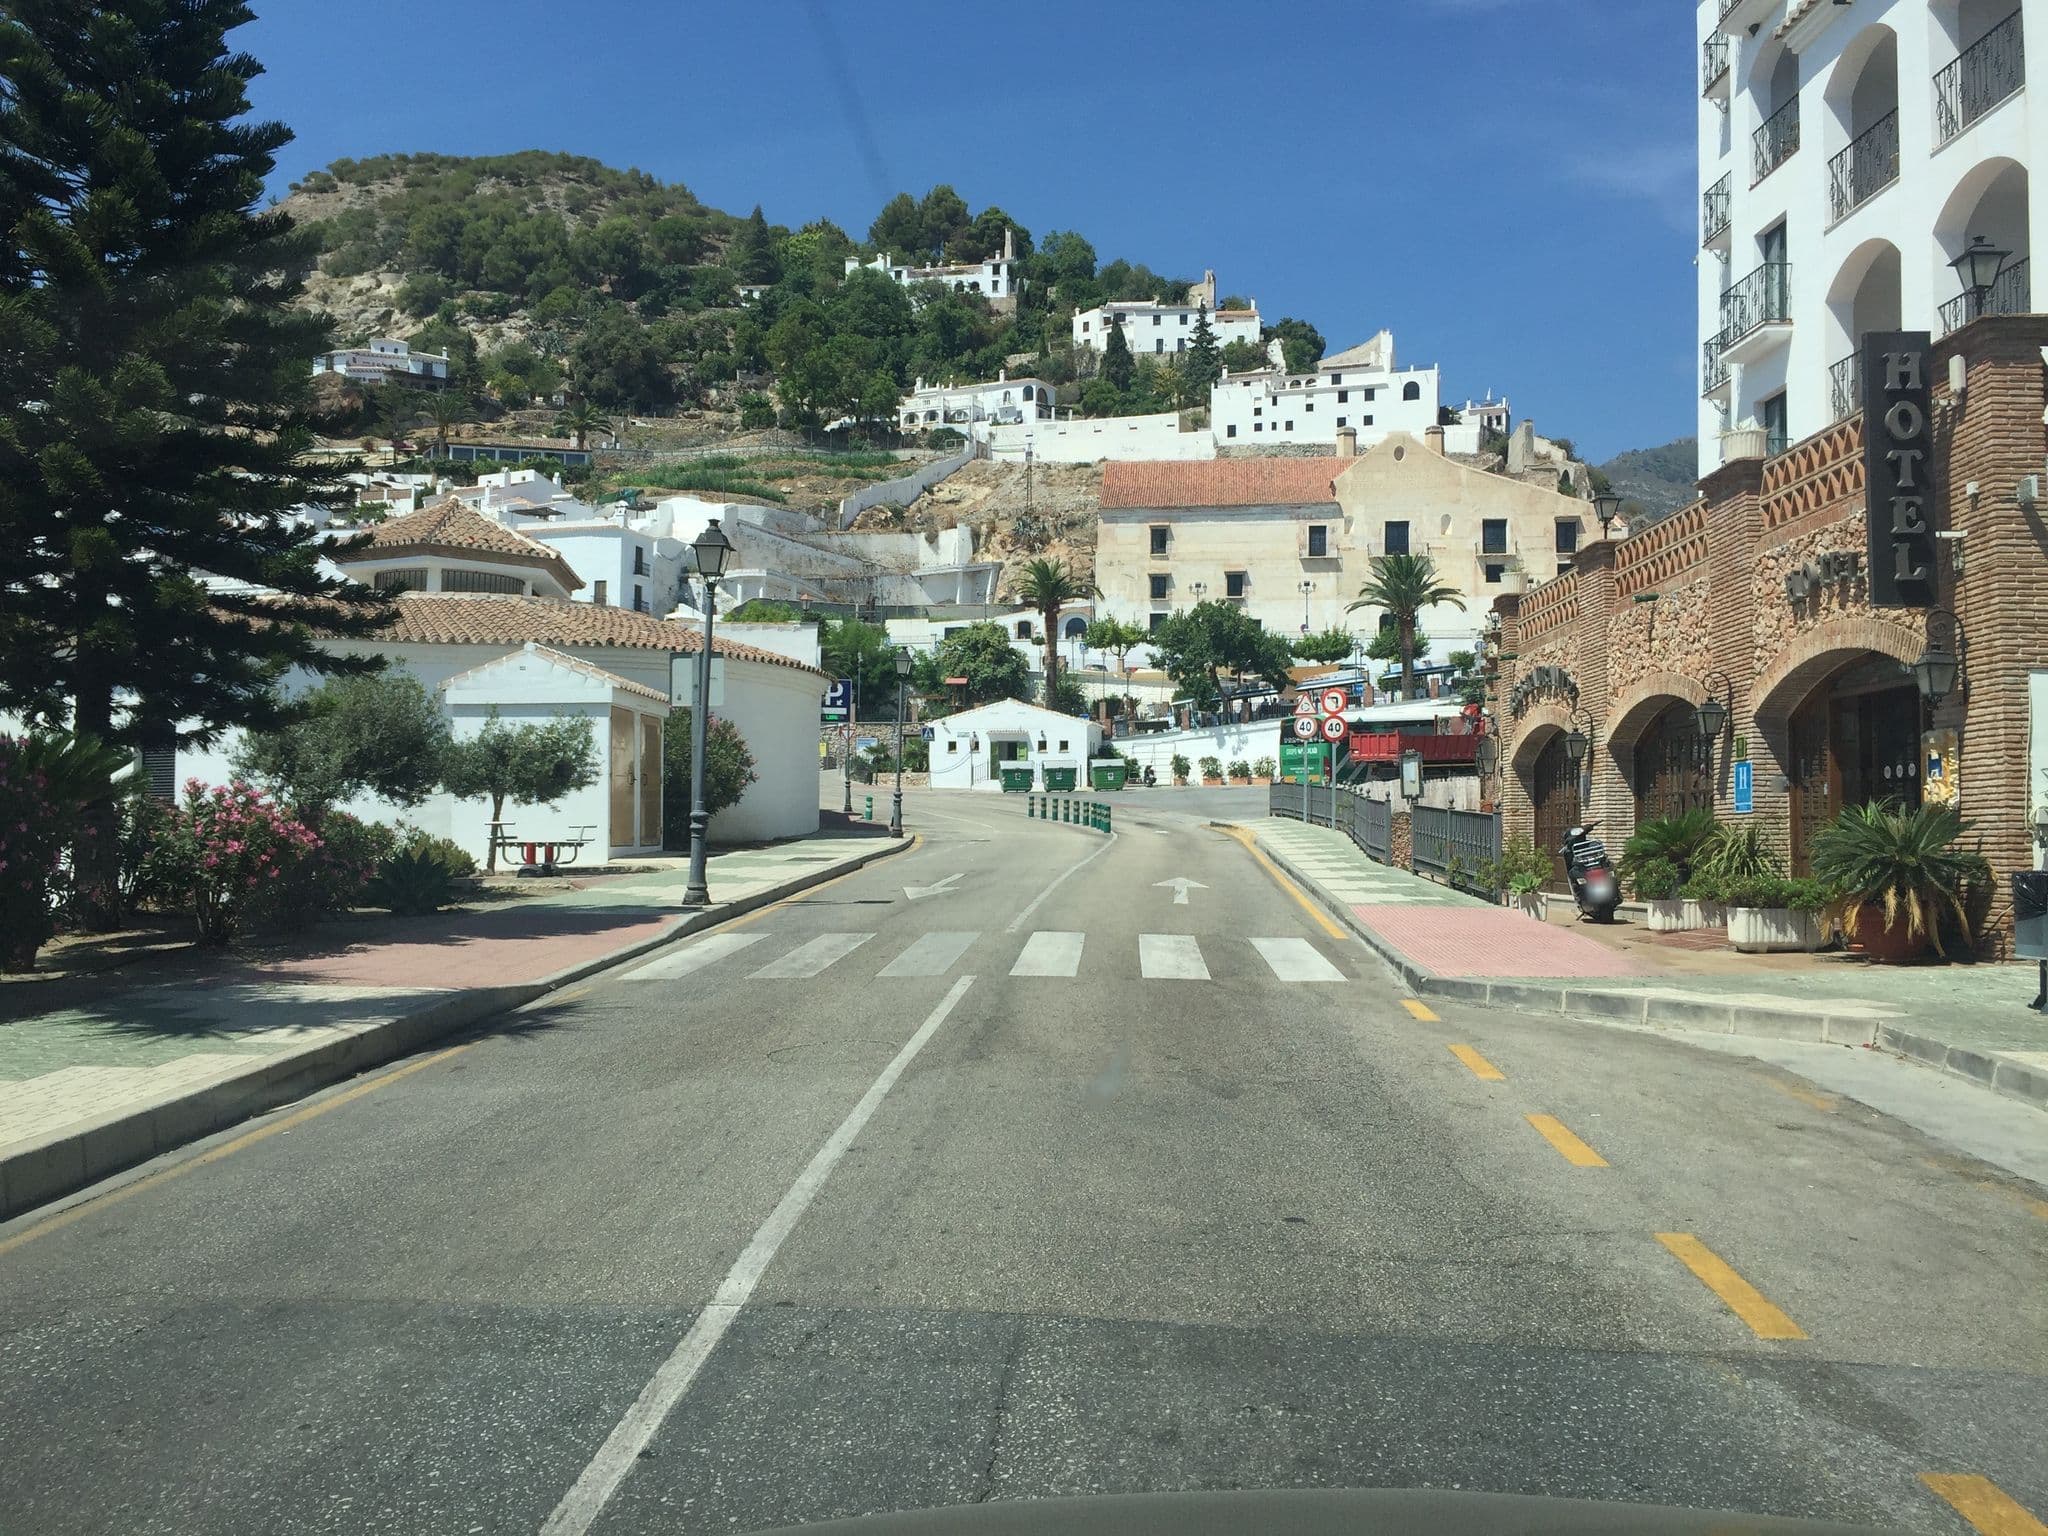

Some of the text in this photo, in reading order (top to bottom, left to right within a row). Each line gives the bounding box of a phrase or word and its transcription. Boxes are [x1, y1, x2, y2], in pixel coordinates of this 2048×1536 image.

[1882, 350, 1927, 581] HOTEL
[825, 681, 844, 706] P
[1299, 721, 1312, 732] 40
[1328, 722, 1341, 733] 40
[1739, 766, 1748, 789] H
